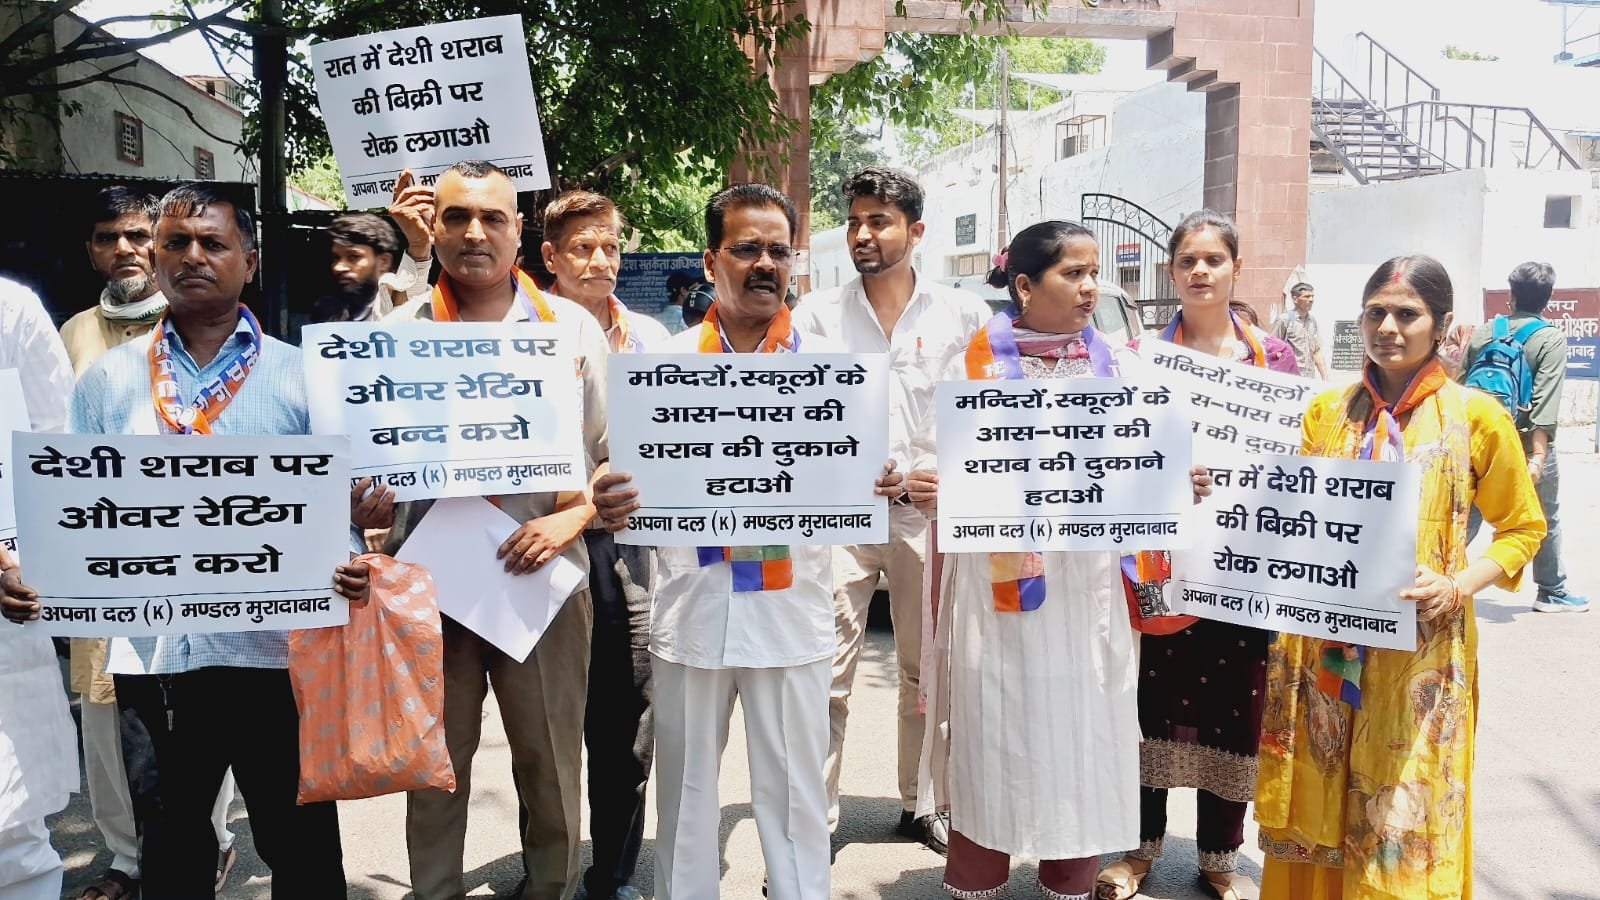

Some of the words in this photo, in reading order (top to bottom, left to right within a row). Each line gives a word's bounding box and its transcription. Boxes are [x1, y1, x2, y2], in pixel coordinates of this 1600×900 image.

[324, 56, 356, 78] रात
[361, 44, 382, 70] में
[387, 36, 433, 66] देशी
[441, 35, 503, 60] शराब
[352, 88, 380, 115] की
[385, 79, 442, 111] बिक्री
[448, 82, 483, 102] पर
[361, 132, 398, 157] रोक
[404, 117, 490, 152] लगाऔ
[352, 182, 378, 196] अपना
[318, 332, 397, 359] देशी
[409, 339, 501, 357] शराब
[511, 339, 558, 356] पर
[345, 375, 448, 404] औवर
[455, 372, 543, 399] रेटिंग
[835, 364, 867, 385] के
[803, 399, 845, 421] की
[1142, 386, 1171, 405] के
[1189, 391, 1272, 424] स-पास
[370, 425, 448, 446] बन्द
[459, 414, 530, 441] करो
[1113, 418, 1151, 438] की
[1206, 425, 1238, 443] की
[29, 446, 126, 478] देशी
[140, 456, 258, 477] शराब
[270, 455, 333, 475] पर
[639, 443, 714, 459] शराब
[721, 435, 764, 457] की
[772, 435, 859, 466] दुकाने
[965, 458, 1031, 473] शराब
[1038, 452, 1077, 471] की
[1084, 450, 1165, 479] दुकाने
[387, 472, 416, 486] दल
[423, 464, 447, 489] (K)
[453, 466, 503, 481] मण्डल
[705, 470, 794, 496] हटाऔ
[1239, 464, 1264, 489] में
[1268, 465, 1317, 494] देशी
[1325, 478, 1395, 501] शराब
[1024, 483, 1104, 505] हटाऔ
[58, 497, 184, 529] औवर
[193, 495, 307, 526] रेटिंग
[627, 514, 673, 533] अपना
[677, 517, 706, 532] दल
[712, 510, 736, 536] (K)
[743, 515, 795, 531] मण्डल
[798, 514, 872, 537] मुरादाबाद
[1216, 504, 1249, 531] की
[1256, 507, 1318, 539] बिक्री
[1325, 522, 1363, 544] पर
[953, 525, 994, 538] अपना
[1000, 525, 1025, 538] दल
[1030, 519, 1052, 542] (K)
[1059, 524, 1106, 537] मण्डल
[1109, 522, 1178, 543] मुरादाबाद
[85, 555, 181, 578] बन्द
[193, 544, 283, 574] करो
[1214, 546, 1260, 573] रोक
[1267, 559, 1359, 589] लगाऔ
[42, 607, 97, 622] अपना
[102, 607, 137, 622] दल
[144, 599, 173, 626] (K)
[181, 602, 242, 618] मण्डल
[246, 597, 331, 623] मुरादाबाद
[1182, 589, 1217, 606] अपना
[1221, 595, 1244, 611] दल
[1248, 595, 1269, 618] (K)
[1276, 604, 1322, 623] मण्डल
[1324, 608, 1400, 634] मुरादाबाद
